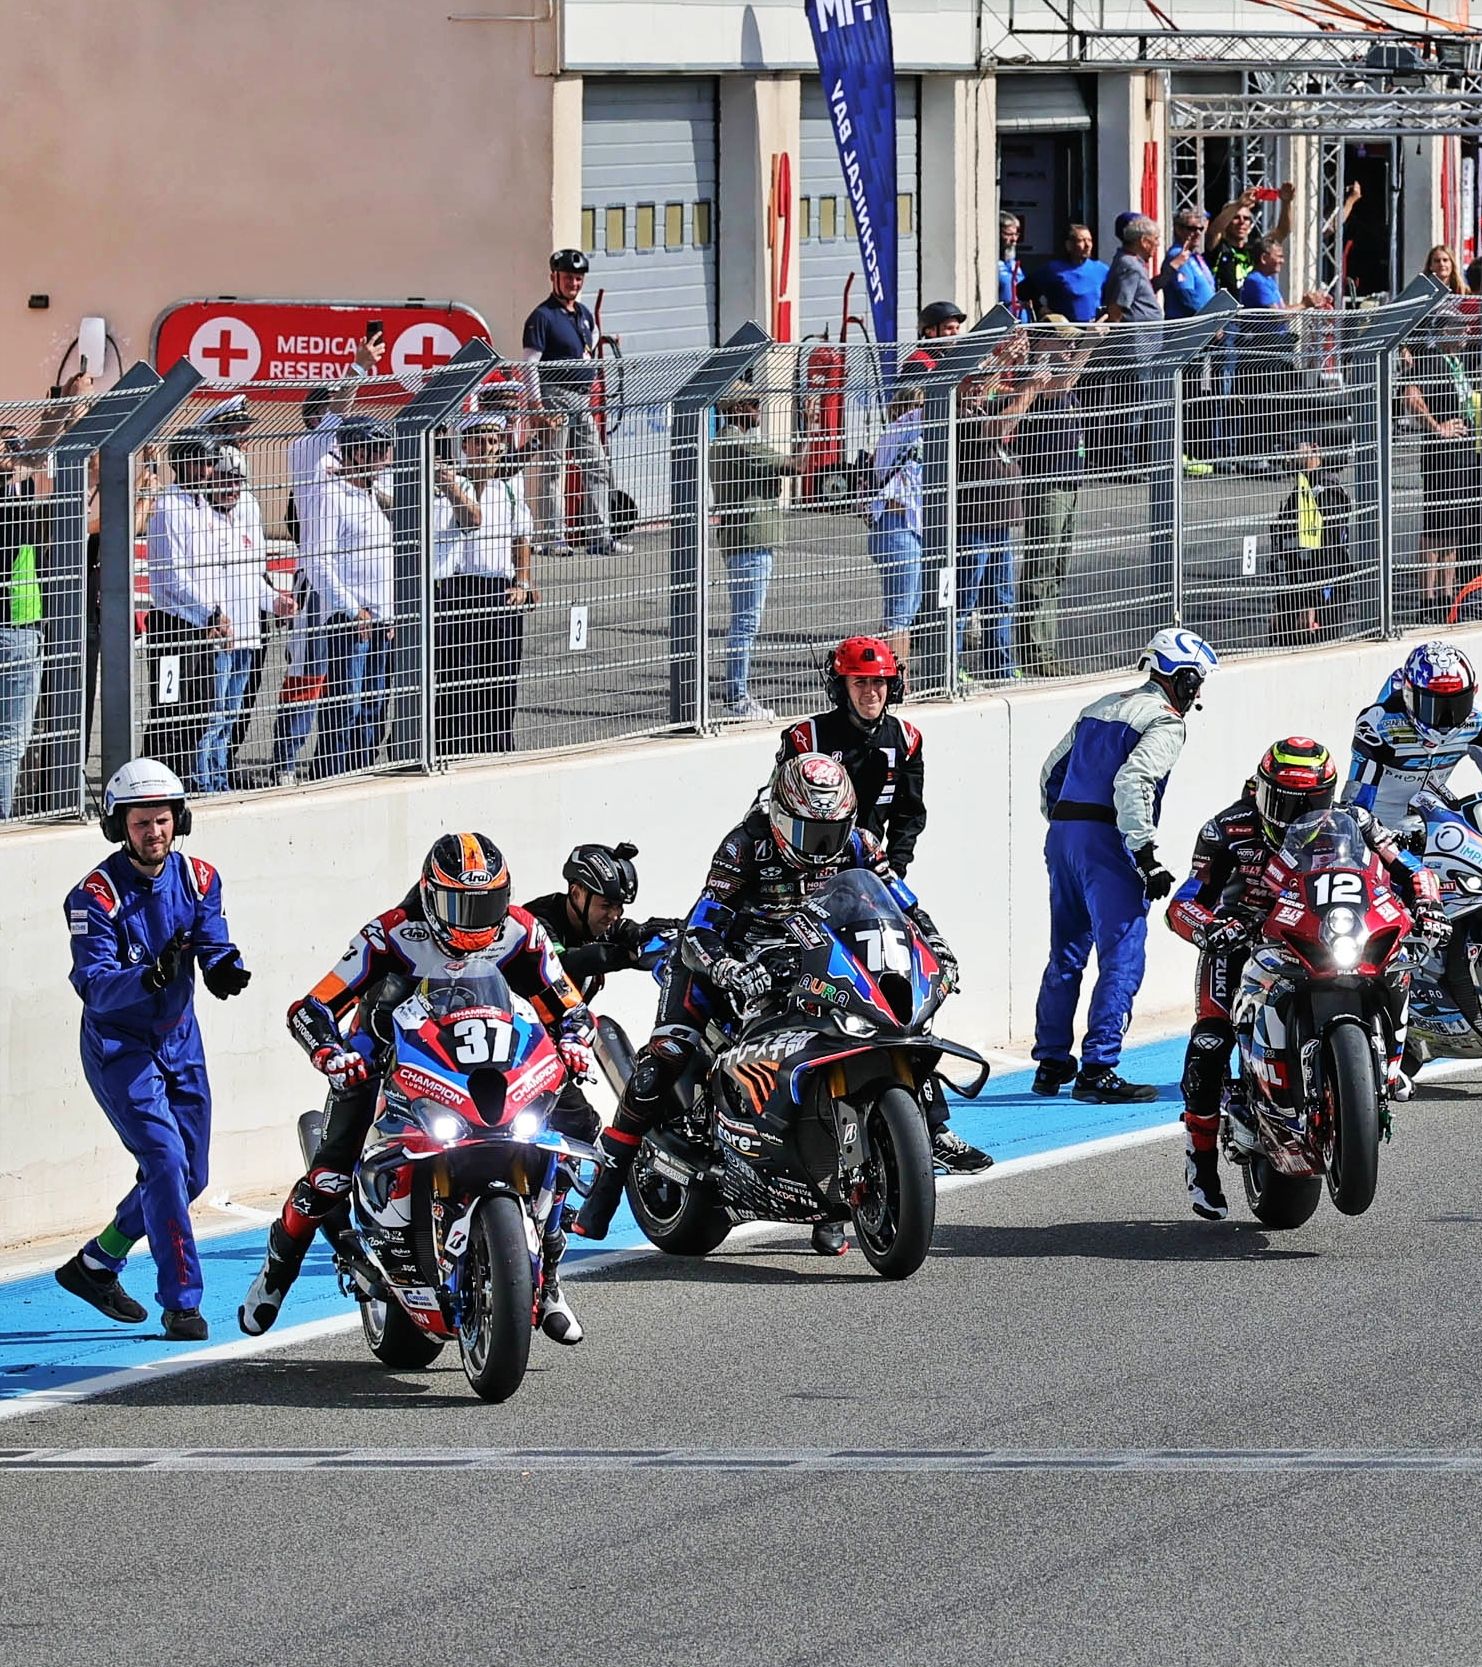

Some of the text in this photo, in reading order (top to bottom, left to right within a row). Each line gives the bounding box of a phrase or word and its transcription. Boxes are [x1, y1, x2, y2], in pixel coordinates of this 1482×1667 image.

[277, 336, 358, 355] MEDICA
[1246, 549, 1253, 569] 5
[943, 580, 950, 601] 4
[575, 620, 582, 642] 3
[166, 670, 173, 694] 2
[465, 871, 489, 882] Arai
[1313, 873, 1361, 906] 12
[808, 901, 831, 919] WRS
[800, 973, 850, 1008] AURA
[453, 1018, 514, 1064] 37
[400, 1068, 465, 1105] CHAMPION
[511, 1062, 559, 1102] CHAMPION
